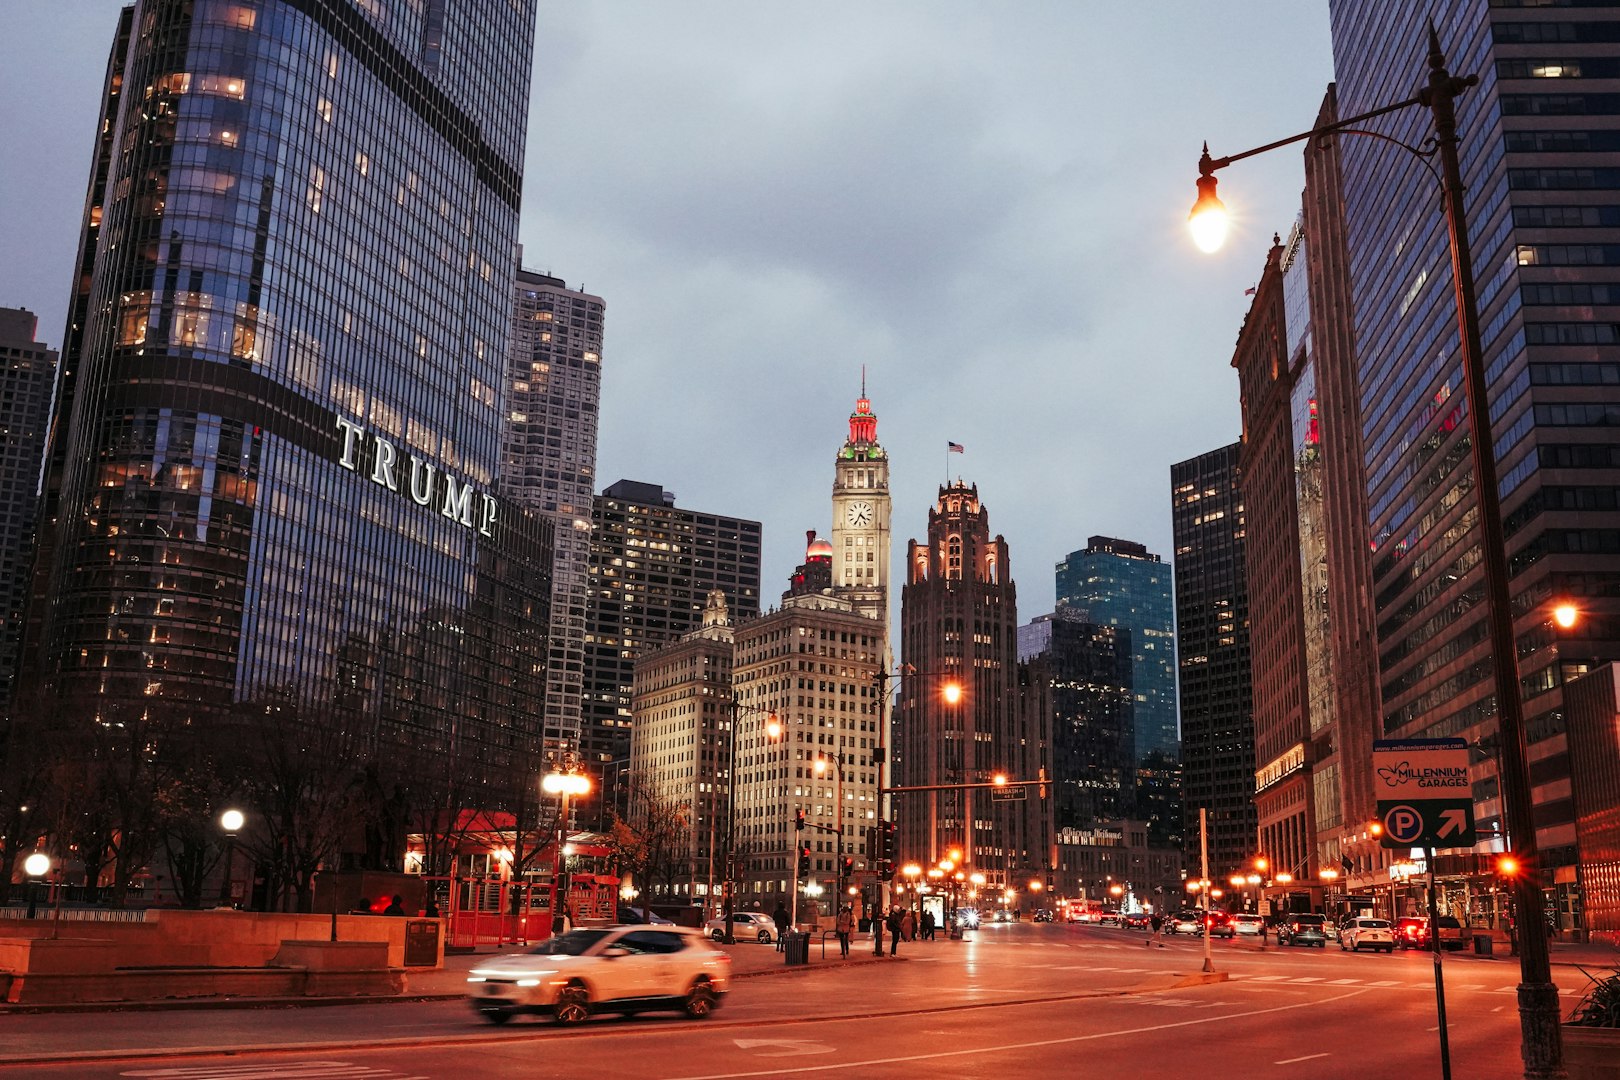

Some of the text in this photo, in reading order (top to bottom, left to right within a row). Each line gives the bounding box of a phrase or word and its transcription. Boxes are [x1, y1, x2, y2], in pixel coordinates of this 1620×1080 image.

[336, 414, 498, 537] TRUMP
[1374, 743, 1464, 752] www.millenniumgarages.com
[1398, 767, 1467, 778] MILLENNIUM
[1418, 778, 1469, 788] GARAGES
[1395, 812, 1415, 836] P
[1062, 826, 1122, 840] Chicago Tribune
